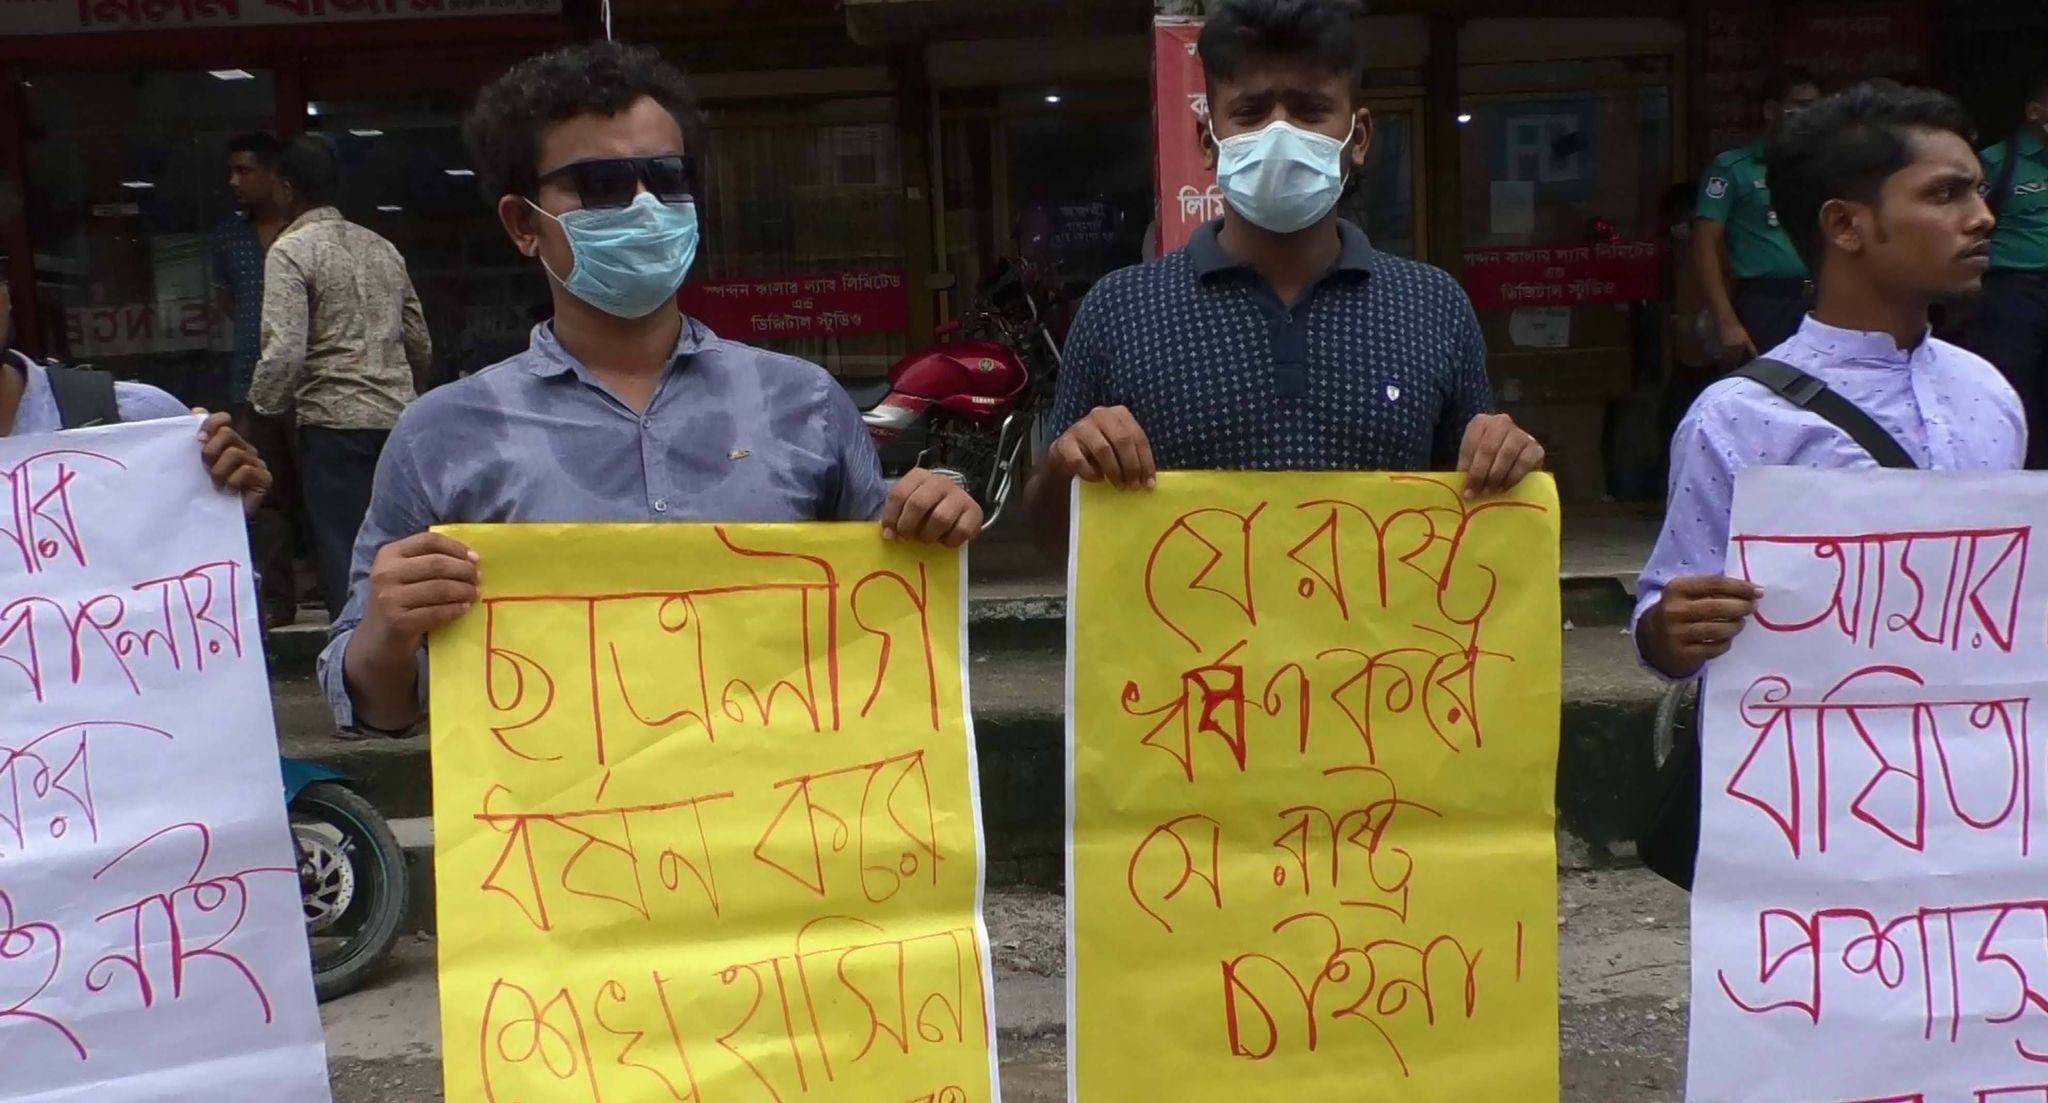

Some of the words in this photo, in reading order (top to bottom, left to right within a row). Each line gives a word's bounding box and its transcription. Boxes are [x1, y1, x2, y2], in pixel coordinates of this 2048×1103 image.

[754, 281, 798, 297] কালার
[804, 279, 836, 294] ল্যাব
[842, 272, 901, 292] লিমিটেড
[751, 312, 811, 333] ডিজিটাল
[1730, 525, 2031, 653] আমার
